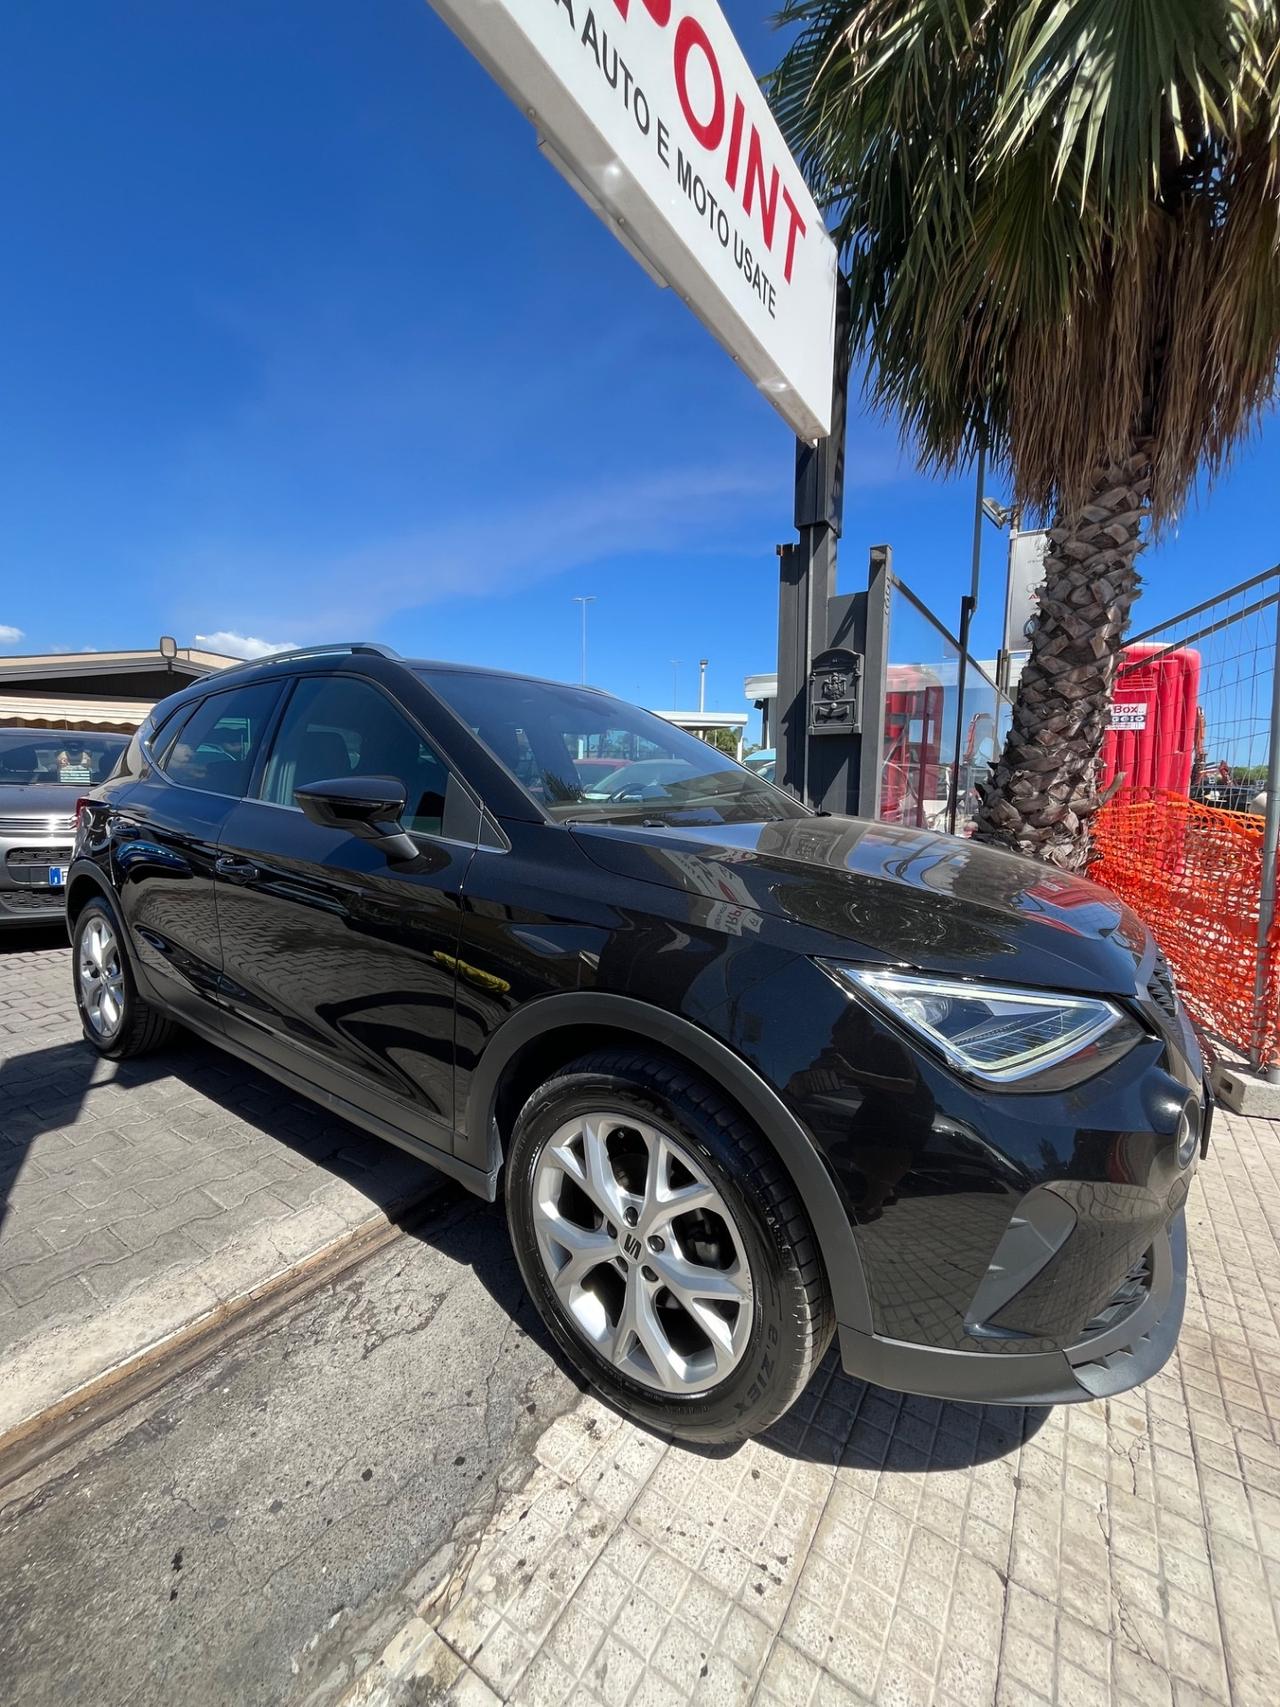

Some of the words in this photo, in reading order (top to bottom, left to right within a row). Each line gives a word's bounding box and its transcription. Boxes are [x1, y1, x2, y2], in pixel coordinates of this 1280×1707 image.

[581, 7, 650, 136] AUTO
[658, 117, 670, 169] E
[677, 147, 730, 249] MOTO
[734, 229, 776, 320] USATE
[612, 0, 807, 286] OINT
